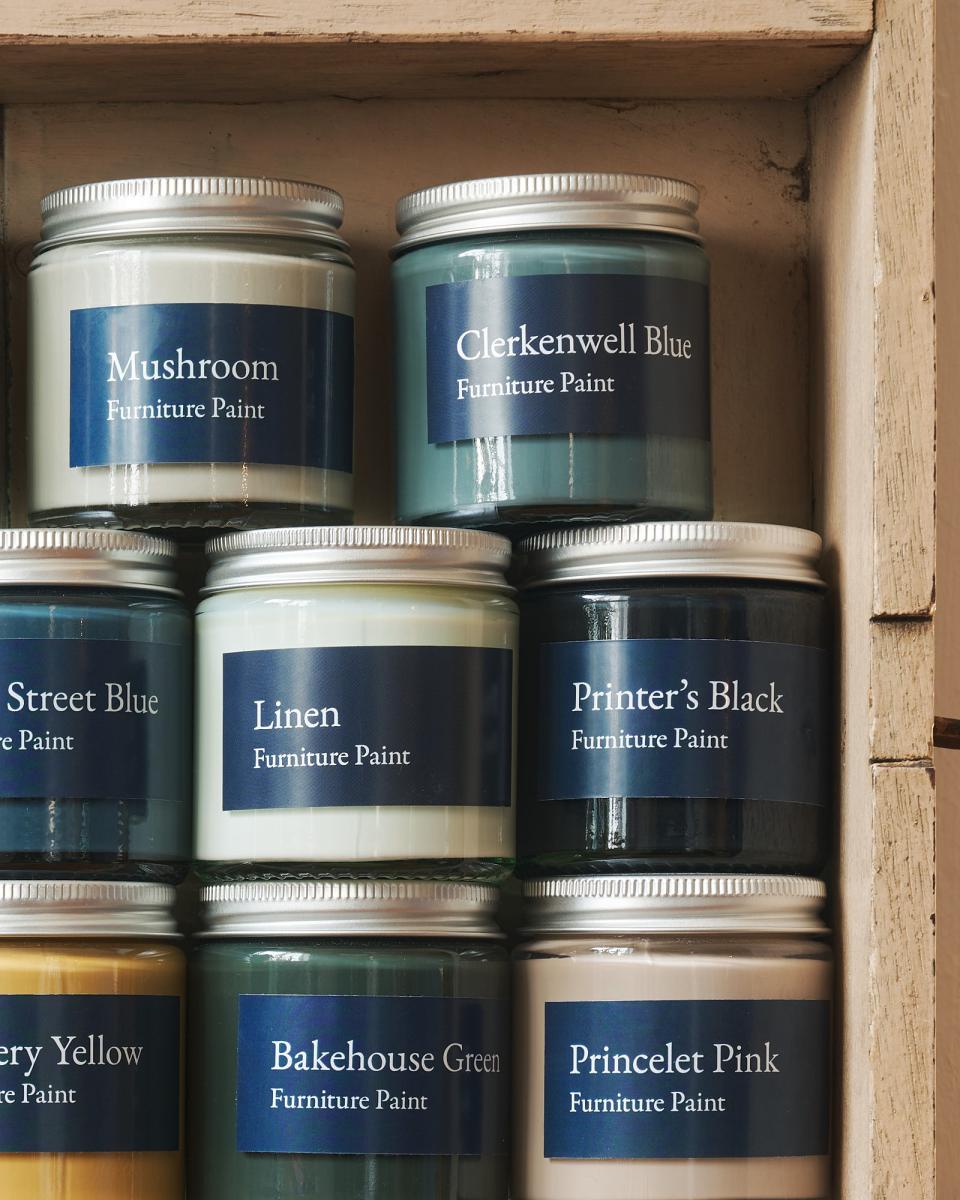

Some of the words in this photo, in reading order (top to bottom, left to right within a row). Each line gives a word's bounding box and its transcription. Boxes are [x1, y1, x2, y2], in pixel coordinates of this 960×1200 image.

[457, 323, 636, 360] Clerkenwell
[644, 325, 691, 358] Blue
[107, 348, 278, 381] Mushroom
[457, 379, 554, 399] Furniture
[560, 372, 614, 392] Paint
[107, 399, 205, 420] Furniture
[212, 397, 264, 419] Paint
[7, 682, 96, 712] Street
[105, 682, 158, 714] Blue
[572, 679, 698, 711] Printer’s
[708, 680, 783, 713] Black
[254, 701, 341, 730] Linen
[19, 730, 74, 750] Paint
[572, 730, 667, 750] Furniture
[674, 728, 728, 748] Paint
[254, 748, 348, 768] Furniture
[355, 745, 410, 765] Paint
[51, 1034, 143, 1065] Yellow
[271, 1040, 434, 1071] Bakehouse
[443, 1043, 499, 1072] Green
[570, 1042, 704, 1074] Princelet
[713, 1042, 779, 1072] Pink
[22, 1083, 76, 1103] Paint
[271, 1088, 369, 1109] Furniture
[376, 1090, 427, 1109] Paint
[570, 1092, 664, 1112] Furniture
[671, 1092, 725, 1111] Paint
